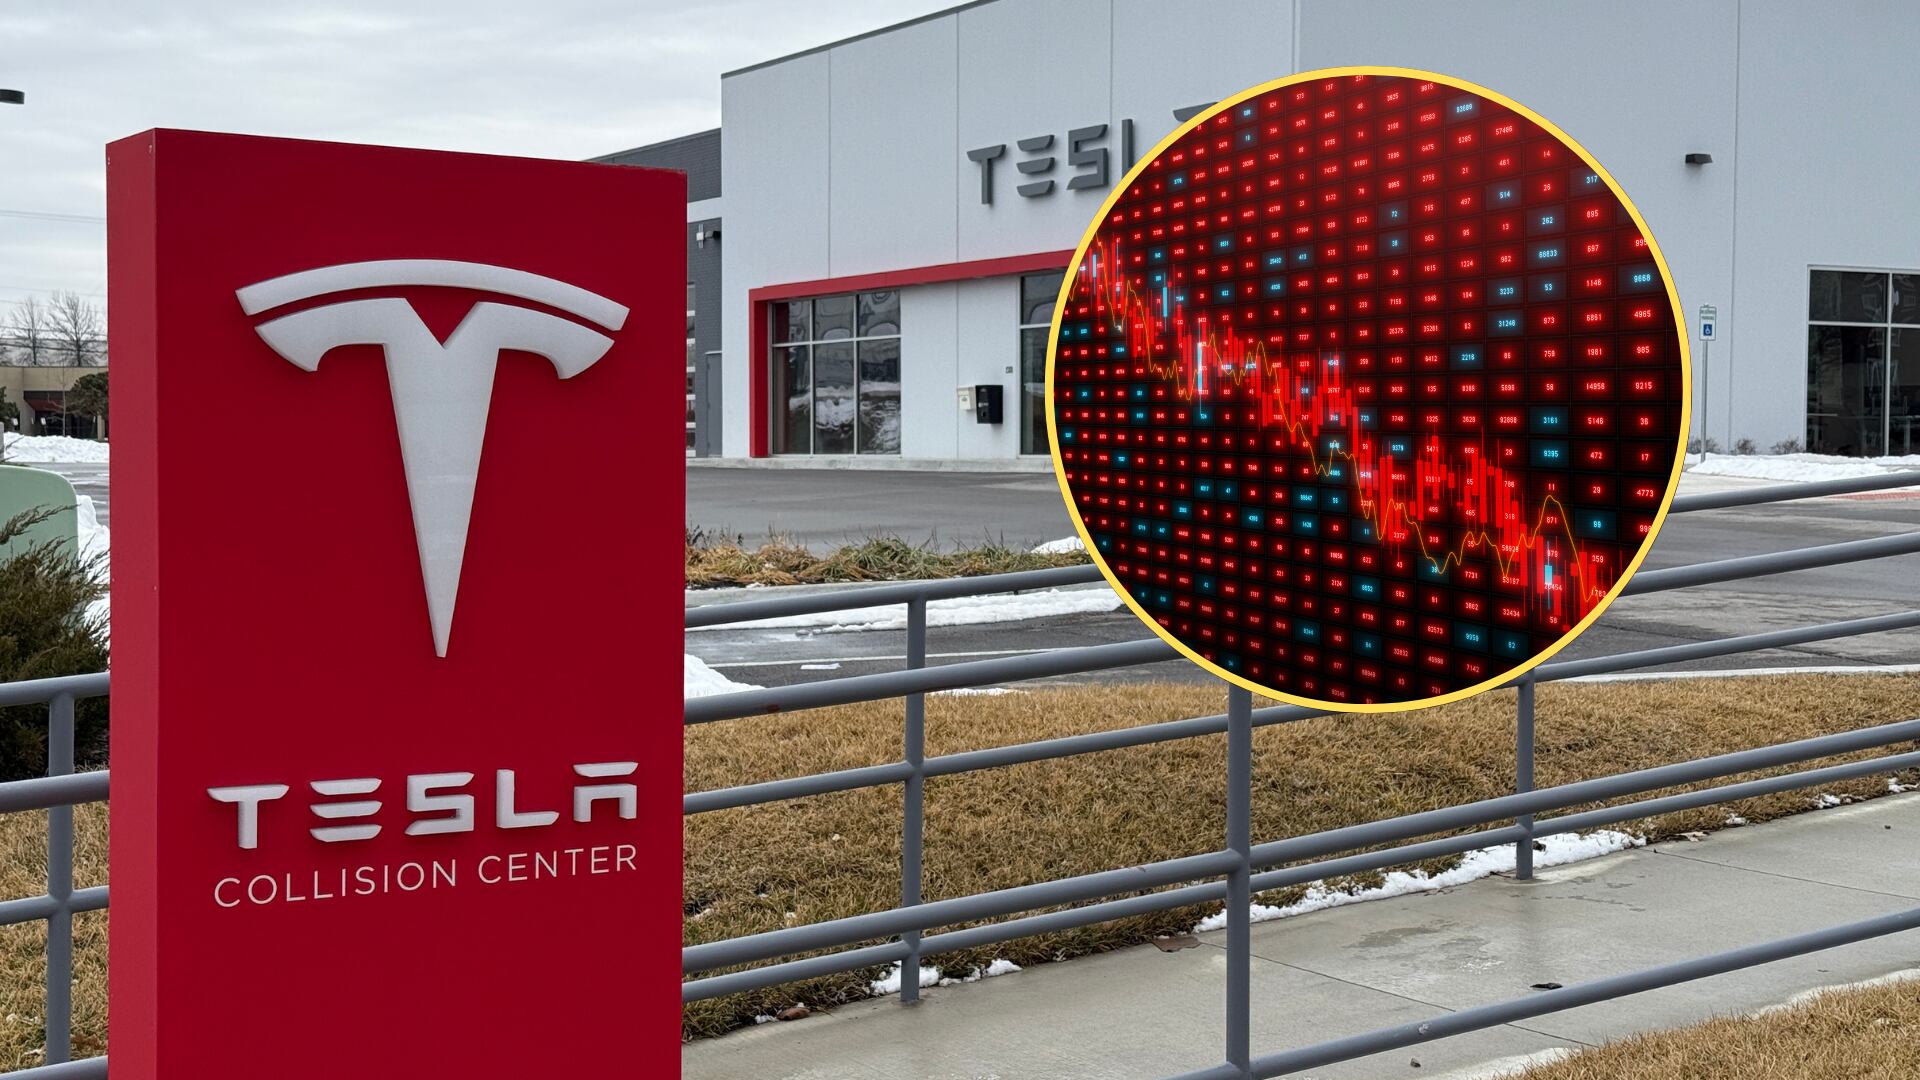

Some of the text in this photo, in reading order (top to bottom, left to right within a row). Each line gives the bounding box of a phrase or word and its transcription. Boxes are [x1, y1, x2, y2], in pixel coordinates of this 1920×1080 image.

[1543, 149, 1551, 158] 14
[1586, 174, 1599, 184] 317
[1460, 197, 1471, 206] 497
[1391, 210, 1398, 218] 72
[1502, 223, 1510, 231] 13
[1544, 283, 1553, 291] 53
[1587, 347, 1602, 356] 1981
[1636, 345, 1650, 354] 985
[1427, 385, 1437, 393] 135
[1426, 415, 1439, 423] 1325
[1590, 451, 1603, 460] 472
[1641, 453, 1649, 461] 17
[1548, 483, 1555, 491] 11
[1636, 489, 1654, 497] 4773
[1546, 516, 1557, 524] 871
[1591, 554, 1604, 564] 359
[1396, 561, 1403, 569] 43
[206, 761, 639, 849] TESLA
[214, 844, 638, 907] COLLISION CENTER
